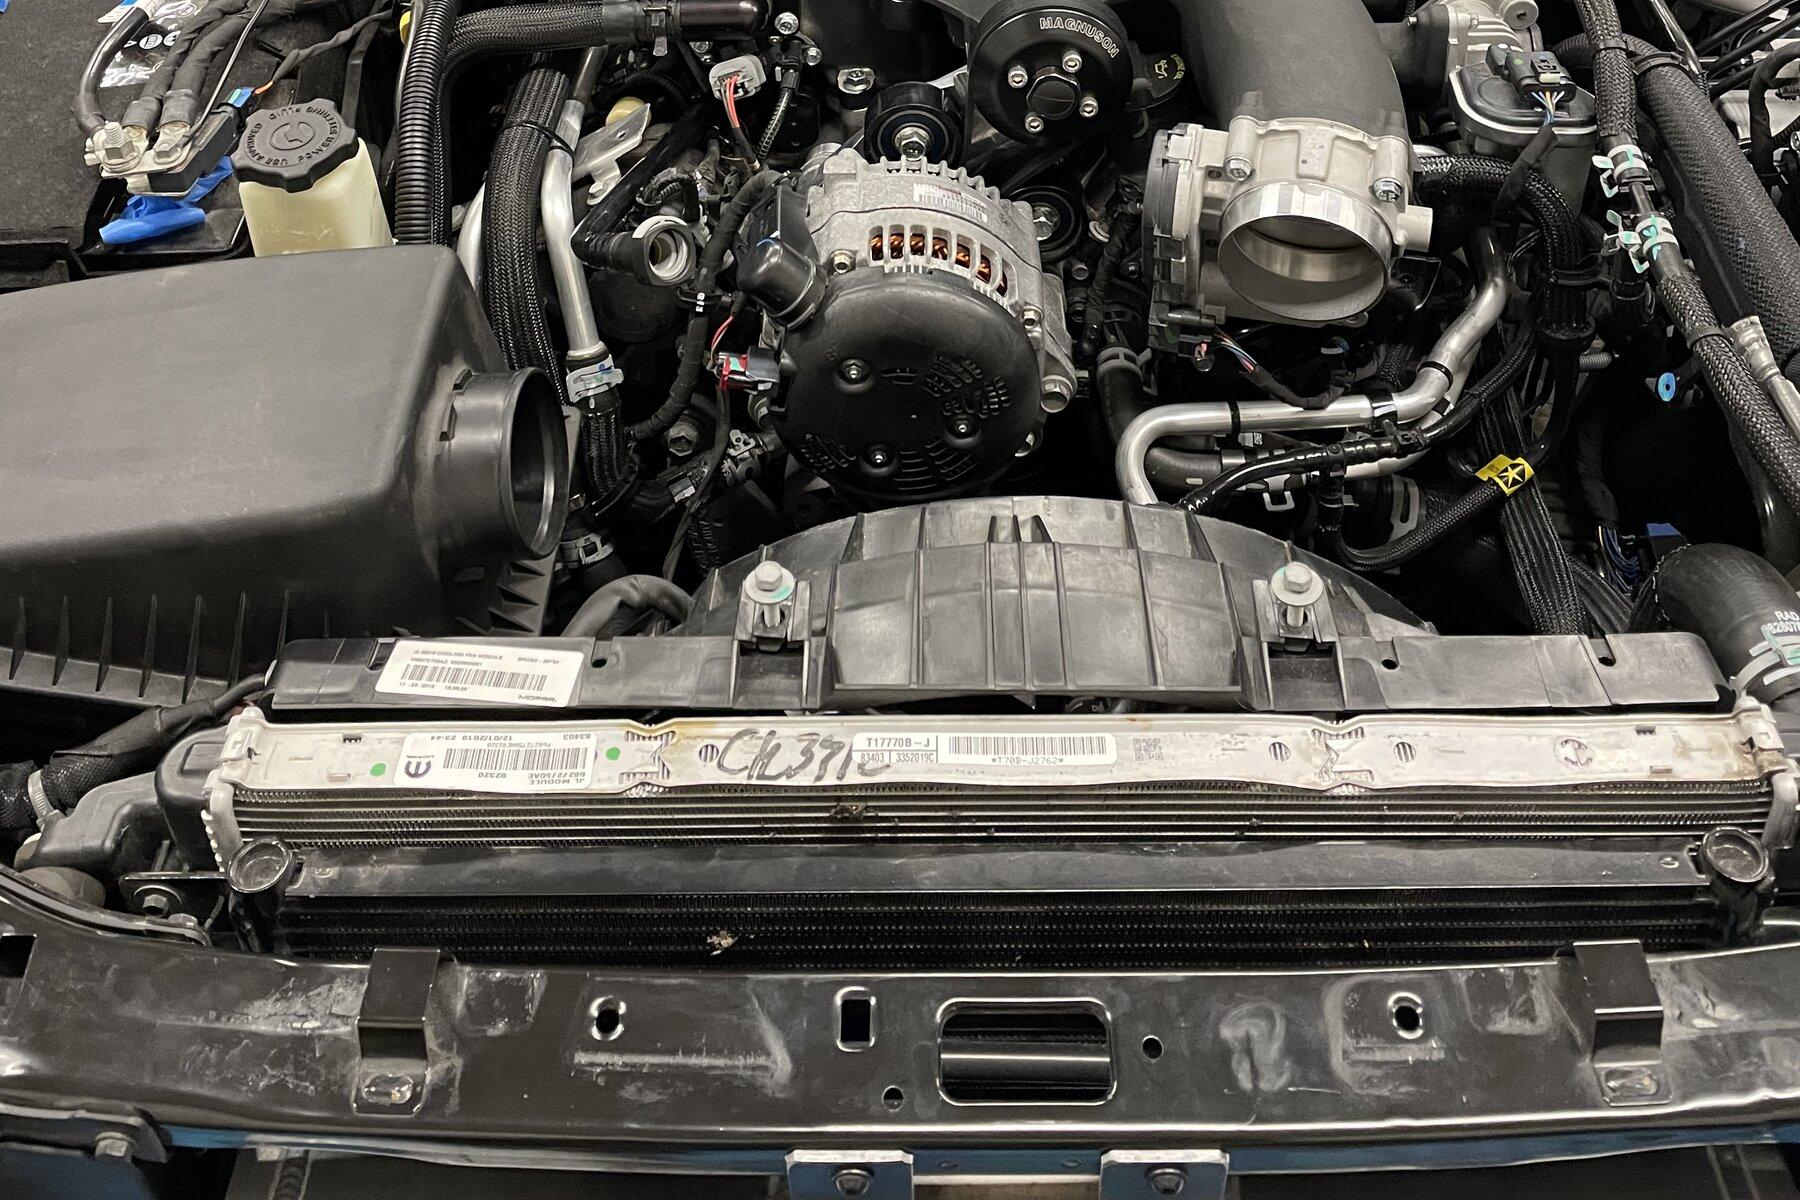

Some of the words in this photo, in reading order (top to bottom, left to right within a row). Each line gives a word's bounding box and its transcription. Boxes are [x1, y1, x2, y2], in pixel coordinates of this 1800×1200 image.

[1039, 16, 1120, 58] MAGNUSON
[268, 107, 301, 120] FLUID
[306, 106, 340, 136] STEERING
[298, 136, 335, 162] POWER
[1774, 610, 1800, 621] RAD
[861, 752, 885, 763] 83403
[896, 752, 934, 763] 3352019C
